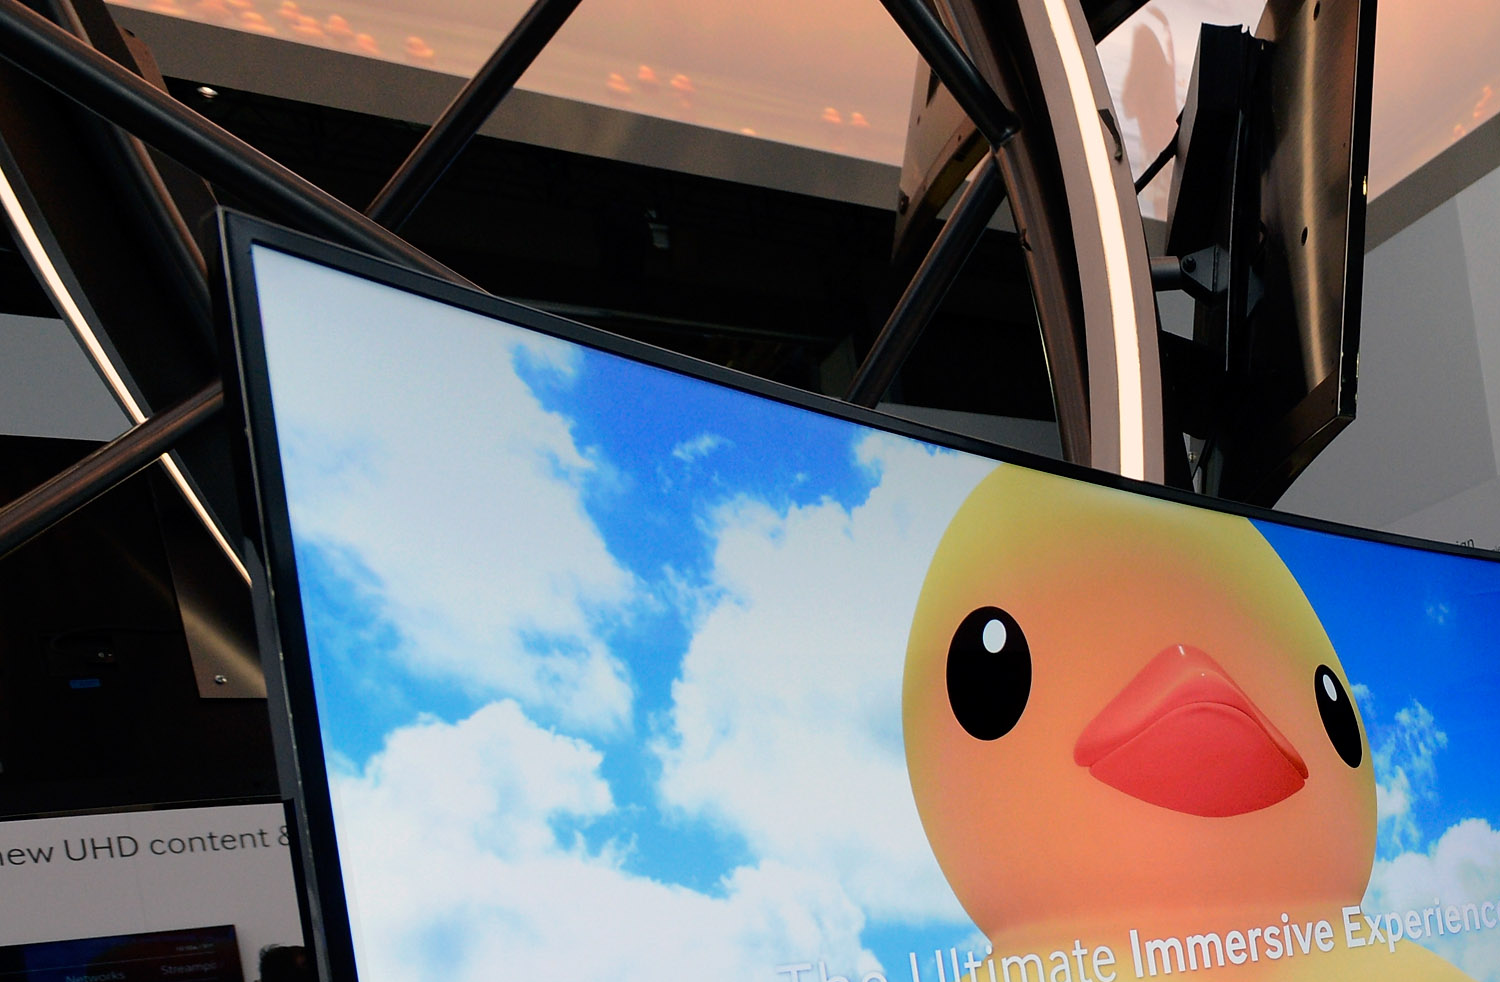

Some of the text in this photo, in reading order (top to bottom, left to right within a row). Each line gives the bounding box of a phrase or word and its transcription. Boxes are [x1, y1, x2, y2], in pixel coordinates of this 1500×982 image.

[64, 835, 139, 862] UHD
[150, 828, 270, 856] content
[1129, 912, 1335, 979] Immersive
